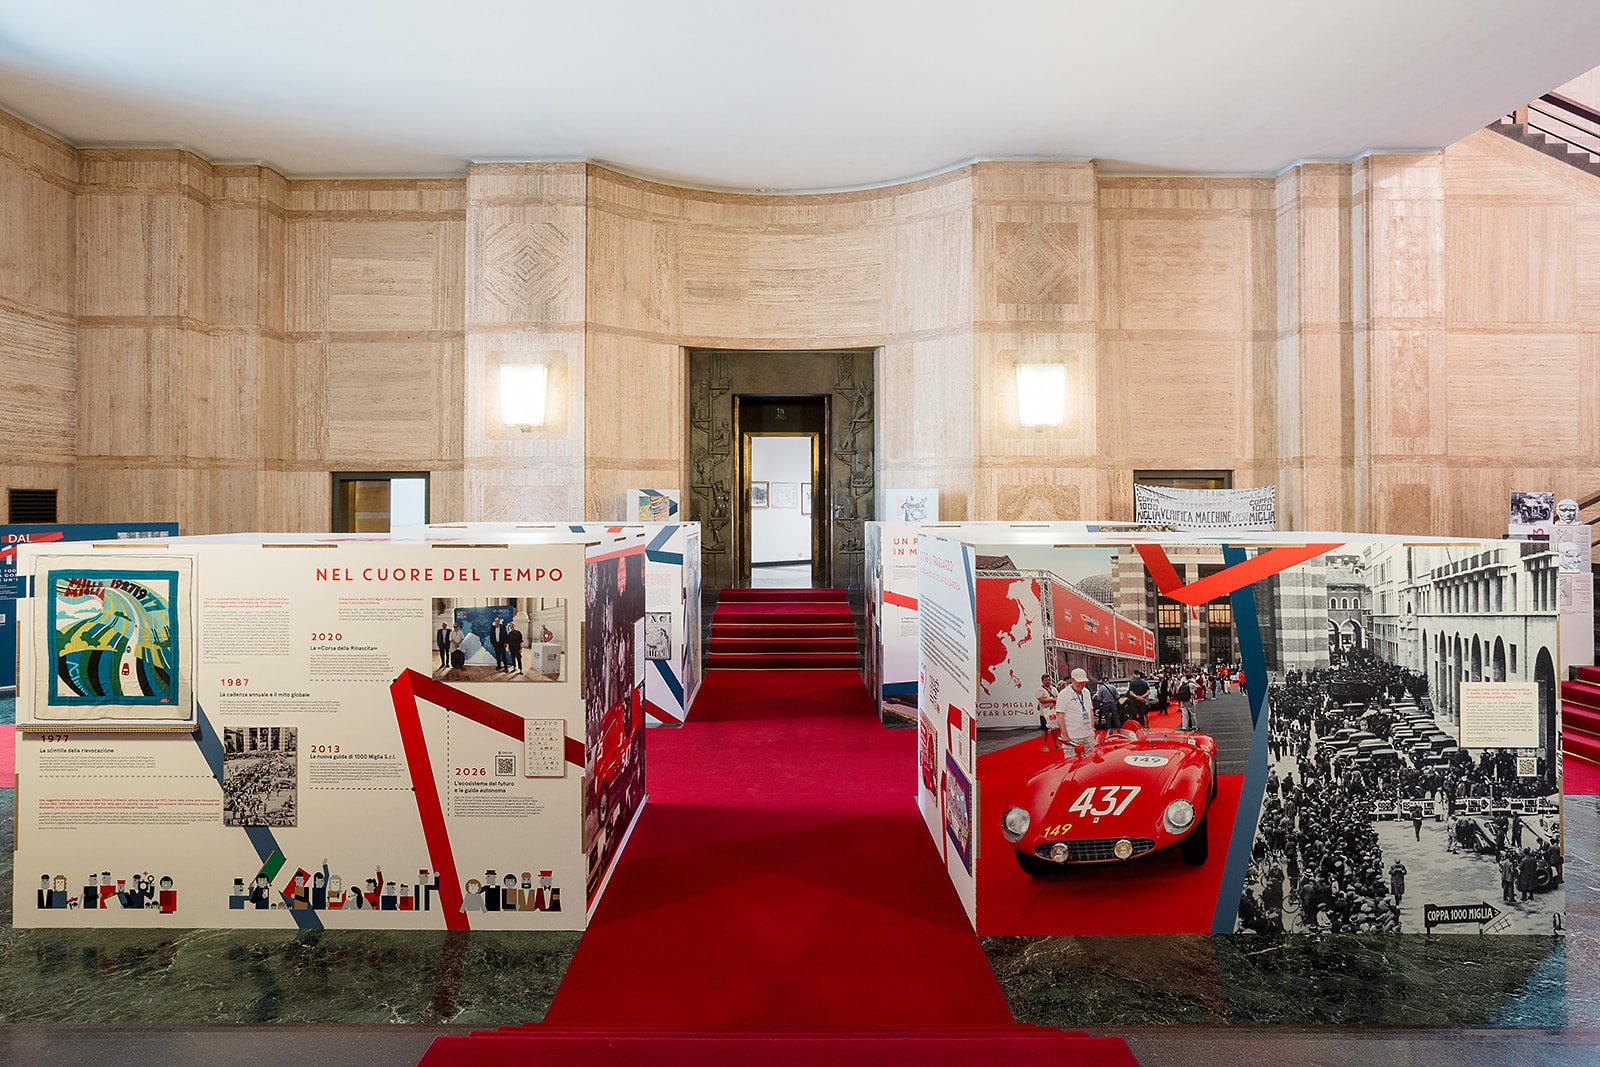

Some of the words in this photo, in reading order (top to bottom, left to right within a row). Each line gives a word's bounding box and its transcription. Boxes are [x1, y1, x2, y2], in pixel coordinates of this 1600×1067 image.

[1160, 508, 1193, 523] VERIFICA
[1196, 511, 1231, 523] MACCHINE
[1249, 511, 1275, 522] MIGLIA
[8, 534, 32, 543] DAL
[316, 568, 353, 581] NEL
[363, 568, 433, 581] CUORE
[443, 568, 480, 581] DEL
[490, 568, 563, 581] TEMPO
[68, 578, 104, 588] MILLE
[312, 633, 342, 641] 2020
[1069, 786, 1142, 818] 437
[1044, 823, 1072, 837] 149
[1427, 910, 1449, 921] COPPA
[1450, 909, 1467, 920] 1000
[1469, 908, 1493, 919] MIGLIA
